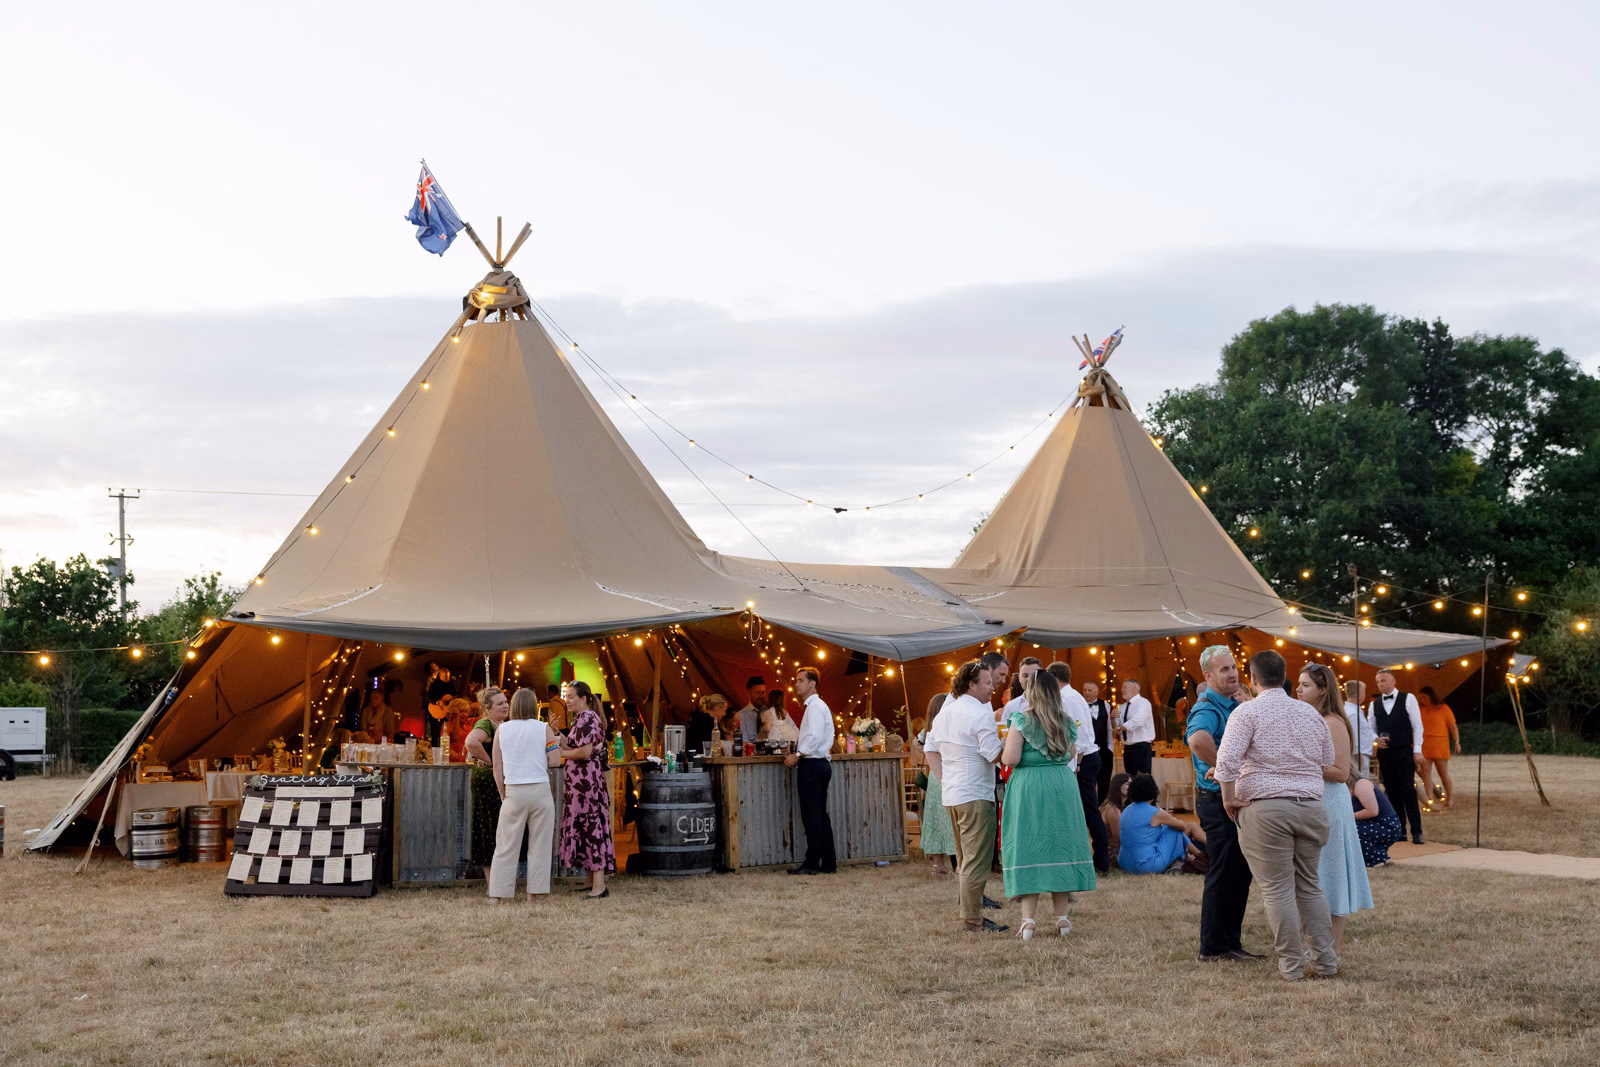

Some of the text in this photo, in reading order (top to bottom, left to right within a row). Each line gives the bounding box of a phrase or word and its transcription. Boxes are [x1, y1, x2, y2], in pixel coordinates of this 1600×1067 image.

[260, 774, 370, 786] Seating Pla
[676, 815, 715, 834] CIDER
